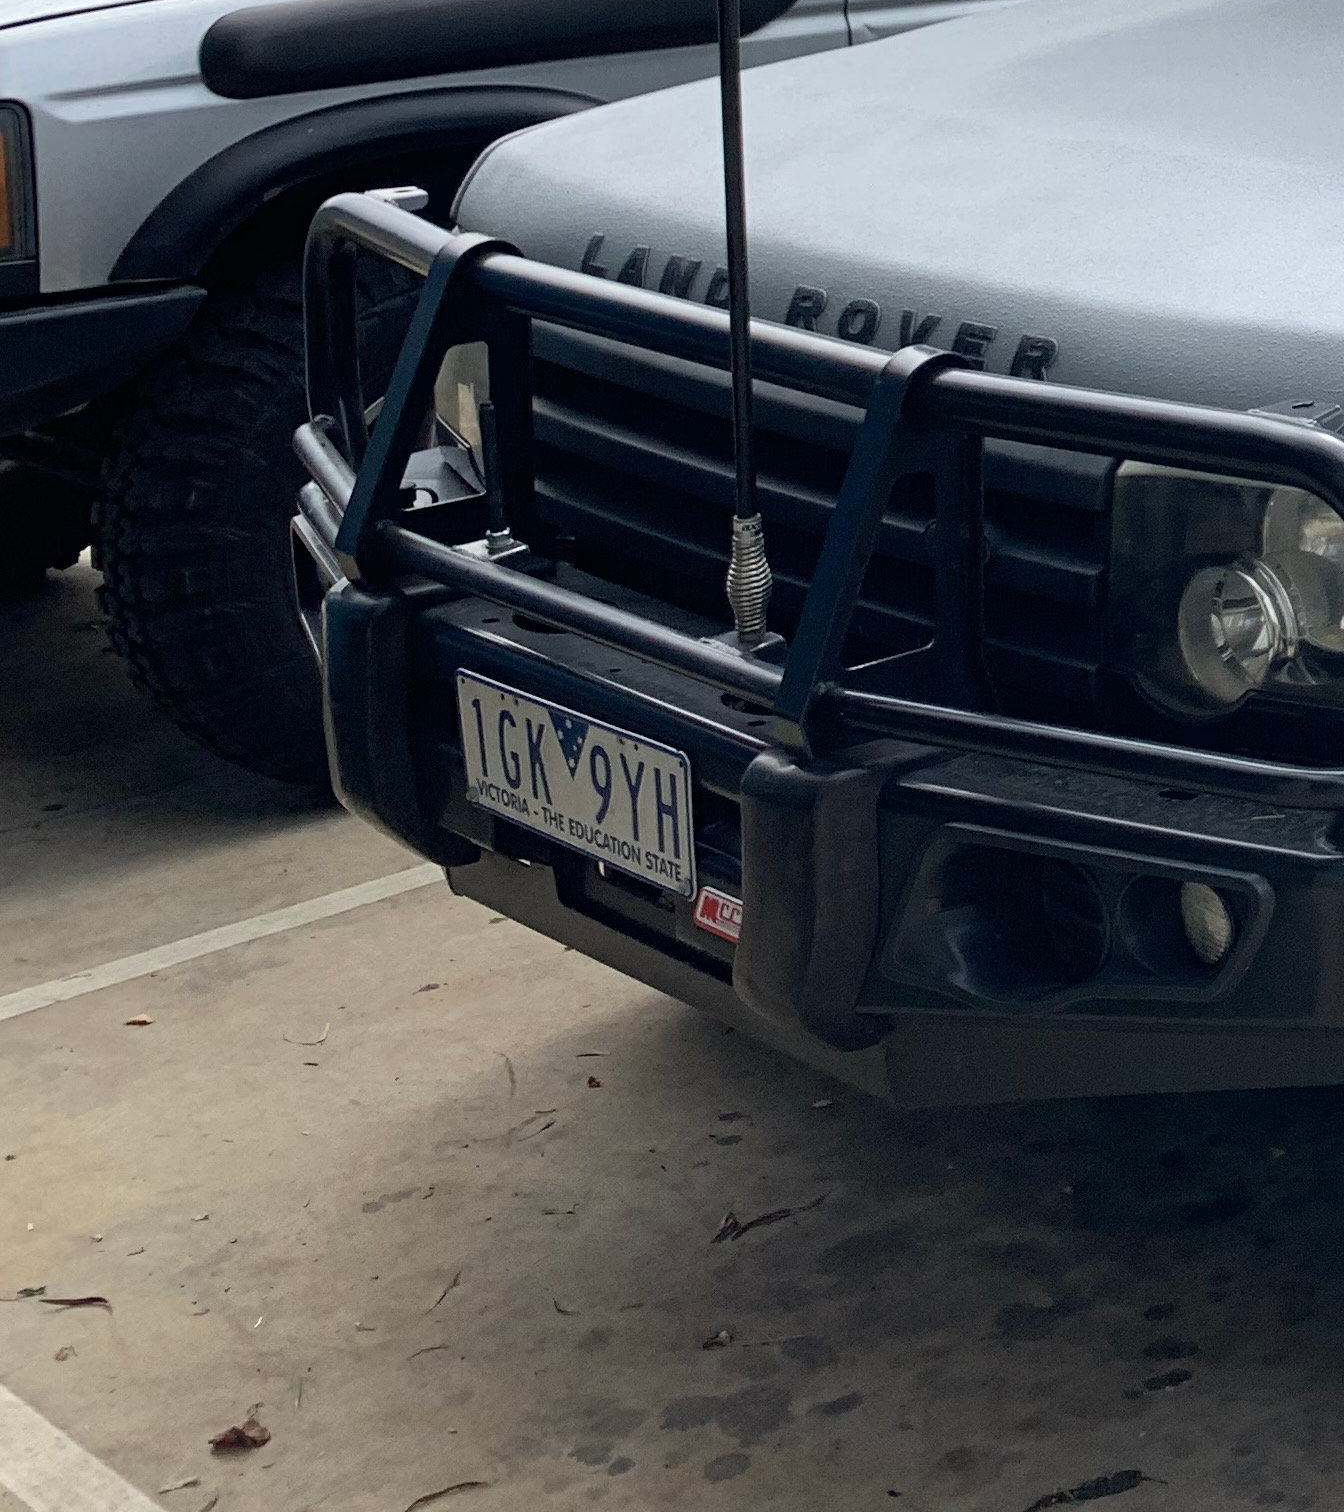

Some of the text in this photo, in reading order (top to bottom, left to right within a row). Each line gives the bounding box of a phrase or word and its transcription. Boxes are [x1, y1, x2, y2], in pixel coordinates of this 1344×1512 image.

[783, 284, 1060, 382] ROVER
[471, 698, 681, 860] 1GK 9YH
[475, 778, 530, 818] VICTORIA
[541, 806, 566, 835] THE
[568, 819, 642, 867] EDUCATION
[645, 851, 683, 883] STATE
